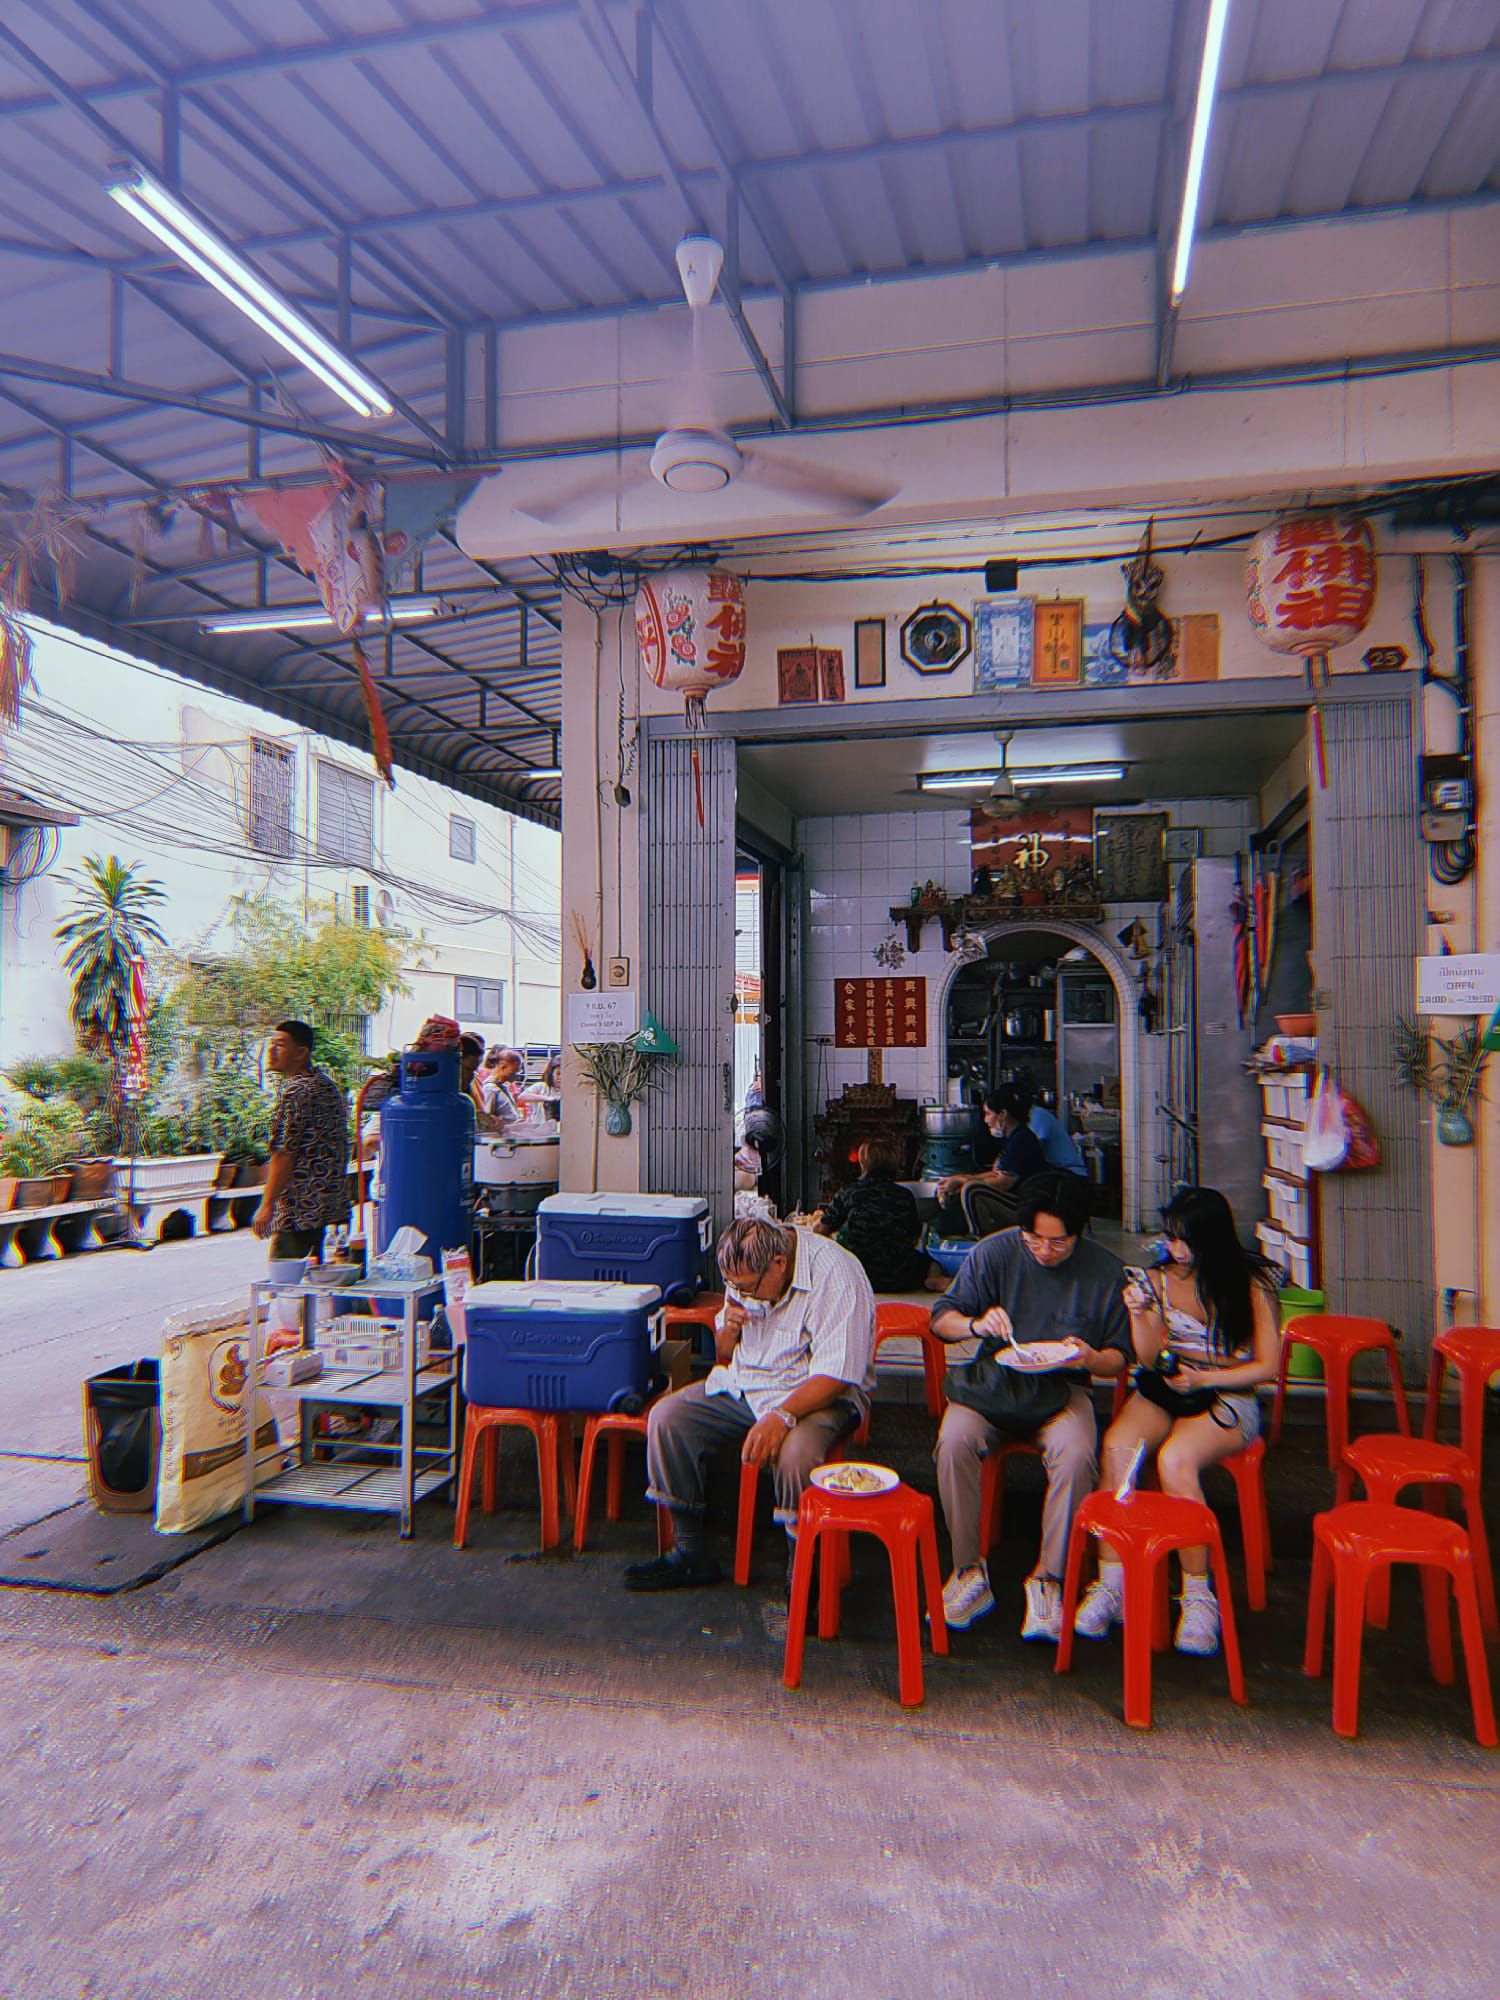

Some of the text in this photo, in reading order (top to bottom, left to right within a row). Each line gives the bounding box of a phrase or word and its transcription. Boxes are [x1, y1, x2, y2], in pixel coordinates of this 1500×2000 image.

[1371, 650, 1399, 666] 25
[1444, 981, 1475, 991] OPEN
[607, 1001, 617, 1010] 67
[841, 981, 857, 1045] 合家平安
[594, 1231, 644, 1244] Superware
